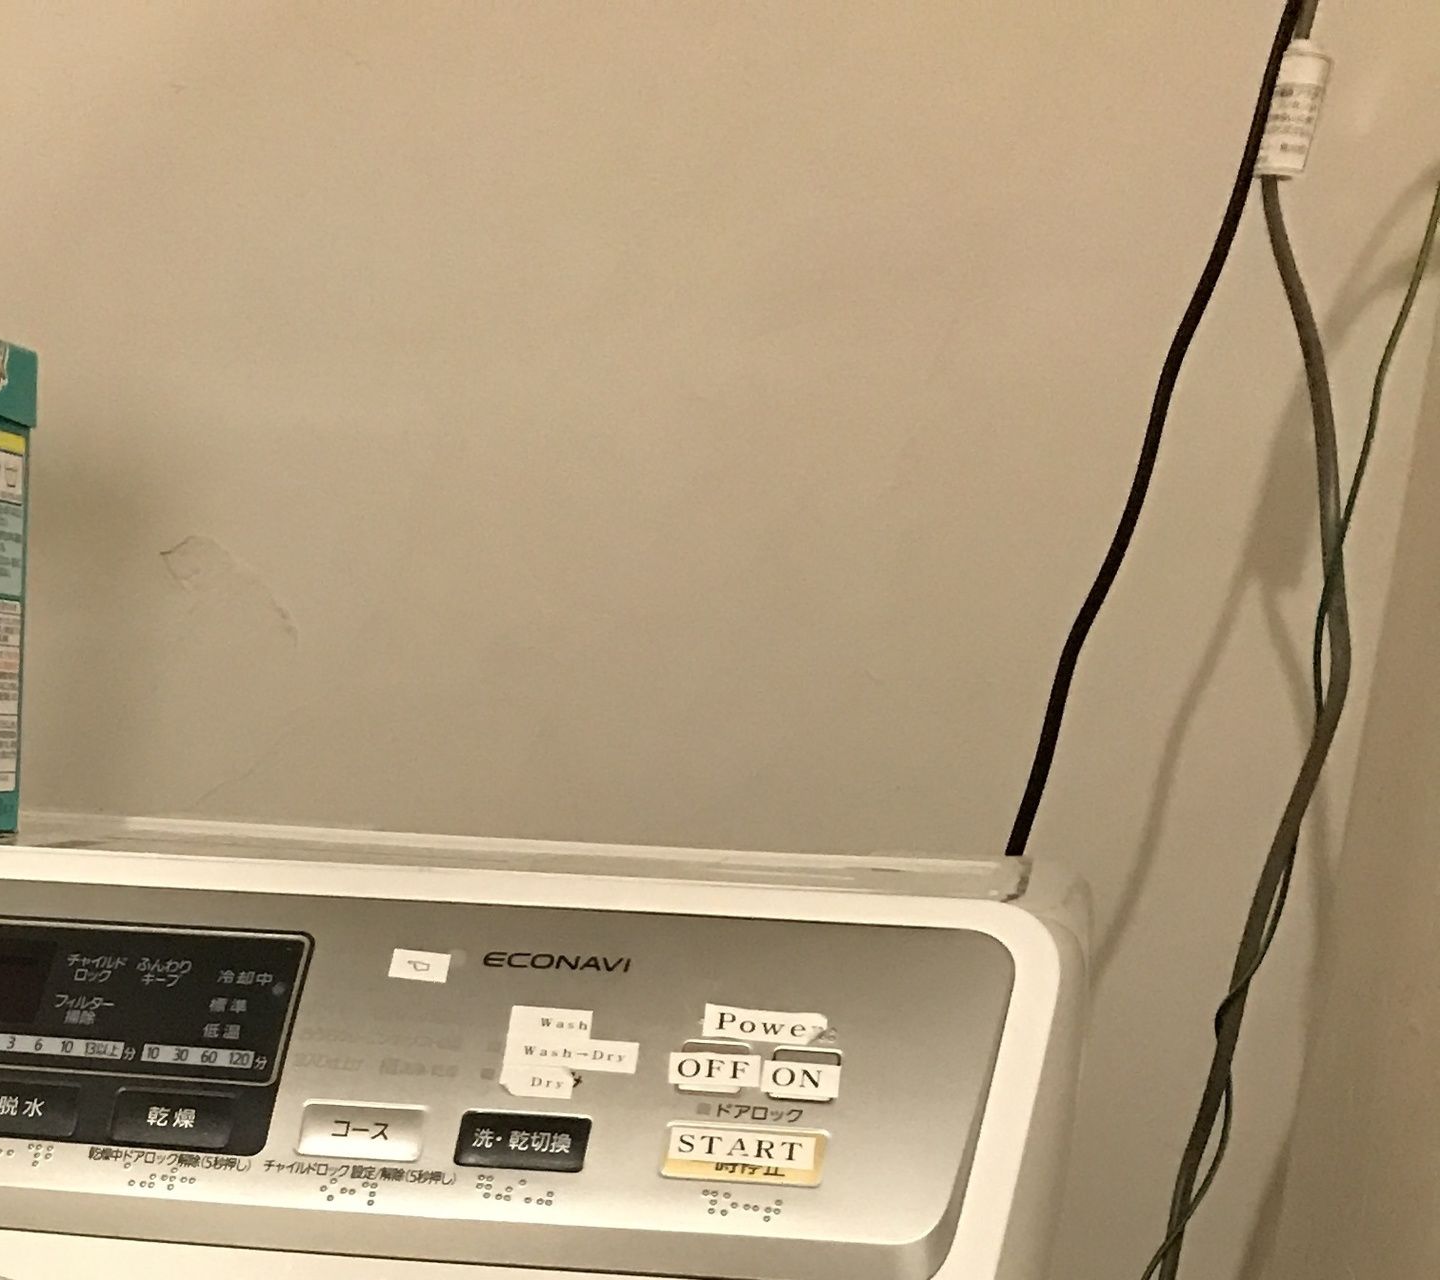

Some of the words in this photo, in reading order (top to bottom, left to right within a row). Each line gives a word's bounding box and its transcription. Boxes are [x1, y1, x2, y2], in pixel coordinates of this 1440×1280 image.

[67, 953, 129, 970] チャイルド
[136, 957, 193, 973] ふんわり
[483, 951, 632, 973] ECONAVI
[73, 968, 113, 983] ロック
[141, 972, 183, 988] キープ
[54, 993, 116, 1010] フィルター
[541, 1018, 588, 1031] Wash
[6, 1036, 16, 1050] 3
[33, 1038, 44, 1052] 6
[60, 1040, 74, 1054] 10
[147, 1046, 161, 1060] 10
[173, 1048, 189, 1062] 30
[200, 1050, 218, 1064] 60
[228, 1051, 250, 1067] 120
[677, 1058, 751, 1080] OFF
[772, 1067, 823, 1089] ON
[531, 1077, 564, 1090] Dry
[146, 1106, 197, 1129] 乾燥
[716, 1103, 804, 1123] ドアロック
[331, 1119, 390, 1141] コース
[678, 1134, 804, 1162] START
